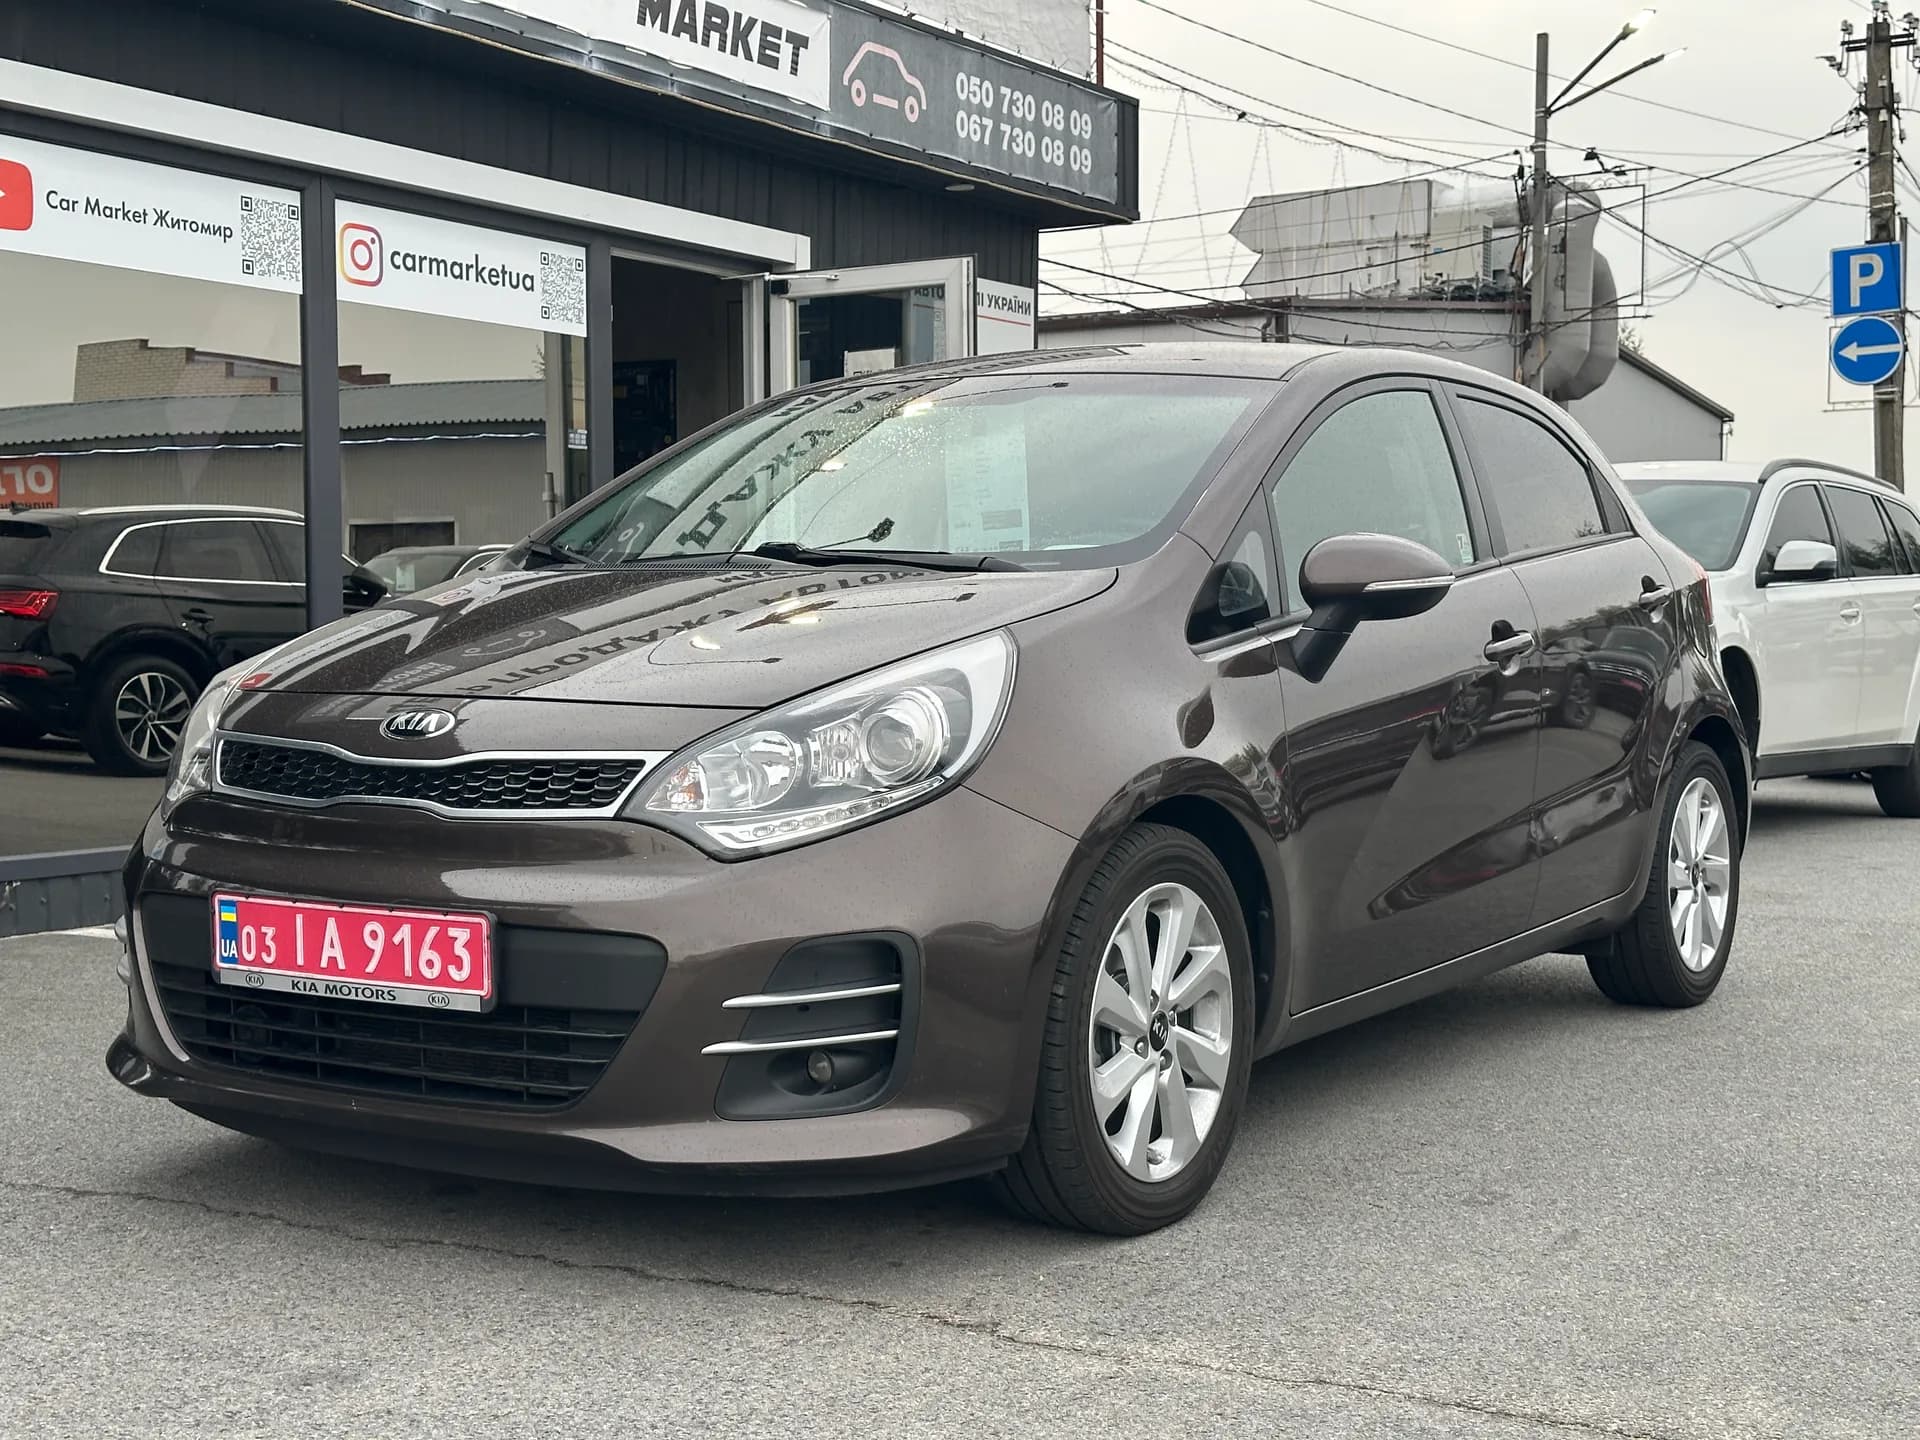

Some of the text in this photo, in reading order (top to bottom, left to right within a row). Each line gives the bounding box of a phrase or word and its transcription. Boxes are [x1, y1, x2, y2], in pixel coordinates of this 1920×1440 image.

[636, 0, 810, 76] MARKET
[955, 71, 1092, 140] 050 730 08 09
[955, 110, 1092, 175] 067 730 08 09
[46, 190, 233, 243] Car Market Житомир
[390, 250, 535, 292] carmarketua
[1849, 253, 1884, 308] P
[987, 293, 1031, 316] УКРАЇНИ
[389, 711, 441, 732] KIA
[221, 938, 238, 958] UA
[241, 925, 276, 965] 03
[362, 921, 471, 982] 9163
[291, 979, 396, 1002] KIA MOTORS
